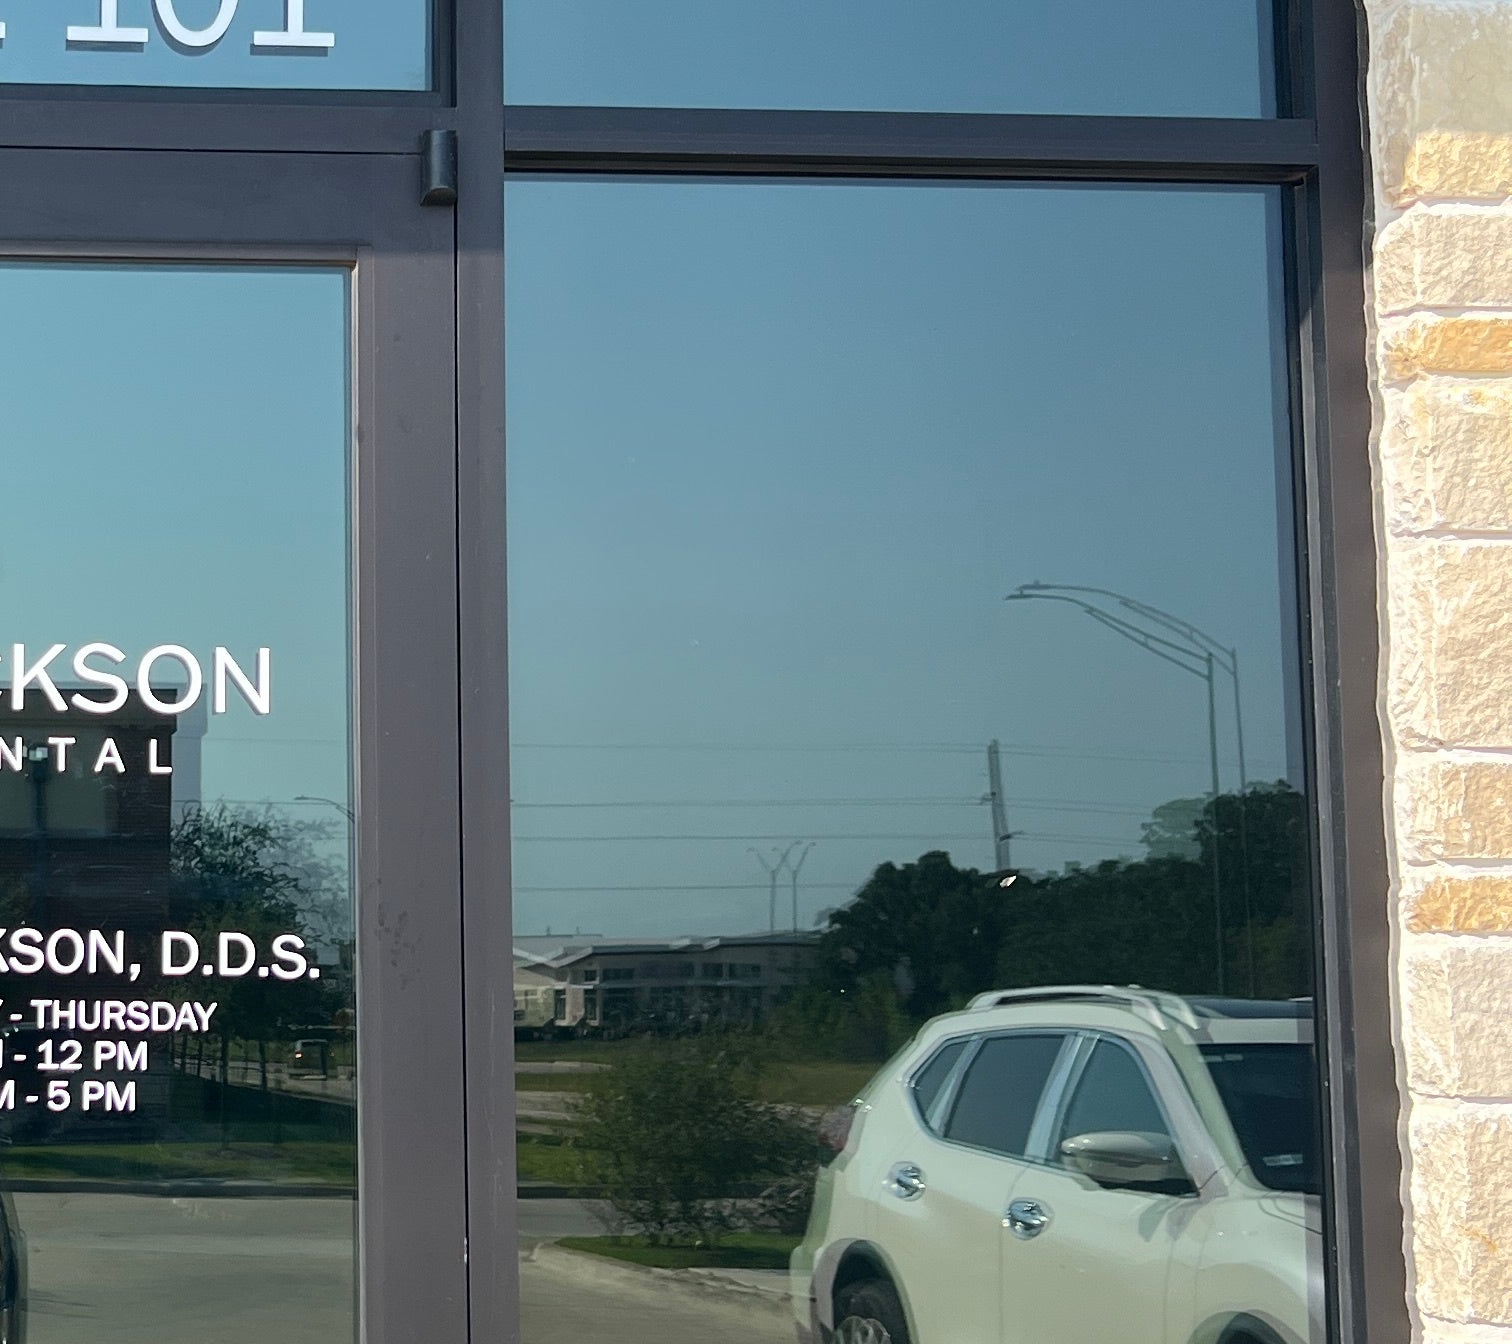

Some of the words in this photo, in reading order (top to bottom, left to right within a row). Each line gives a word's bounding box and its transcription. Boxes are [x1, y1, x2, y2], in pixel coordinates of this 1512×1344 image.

[161, 930, 321, 980] D.D.S.
[29, 999, 219, 1033] THURSDAY
[36, 1039, 84, 1071] 12
[93, 1040, 149, 1072] PM
[46, 1079, 72, 1112] 5
[81, 1080, 137, 1112] PM
